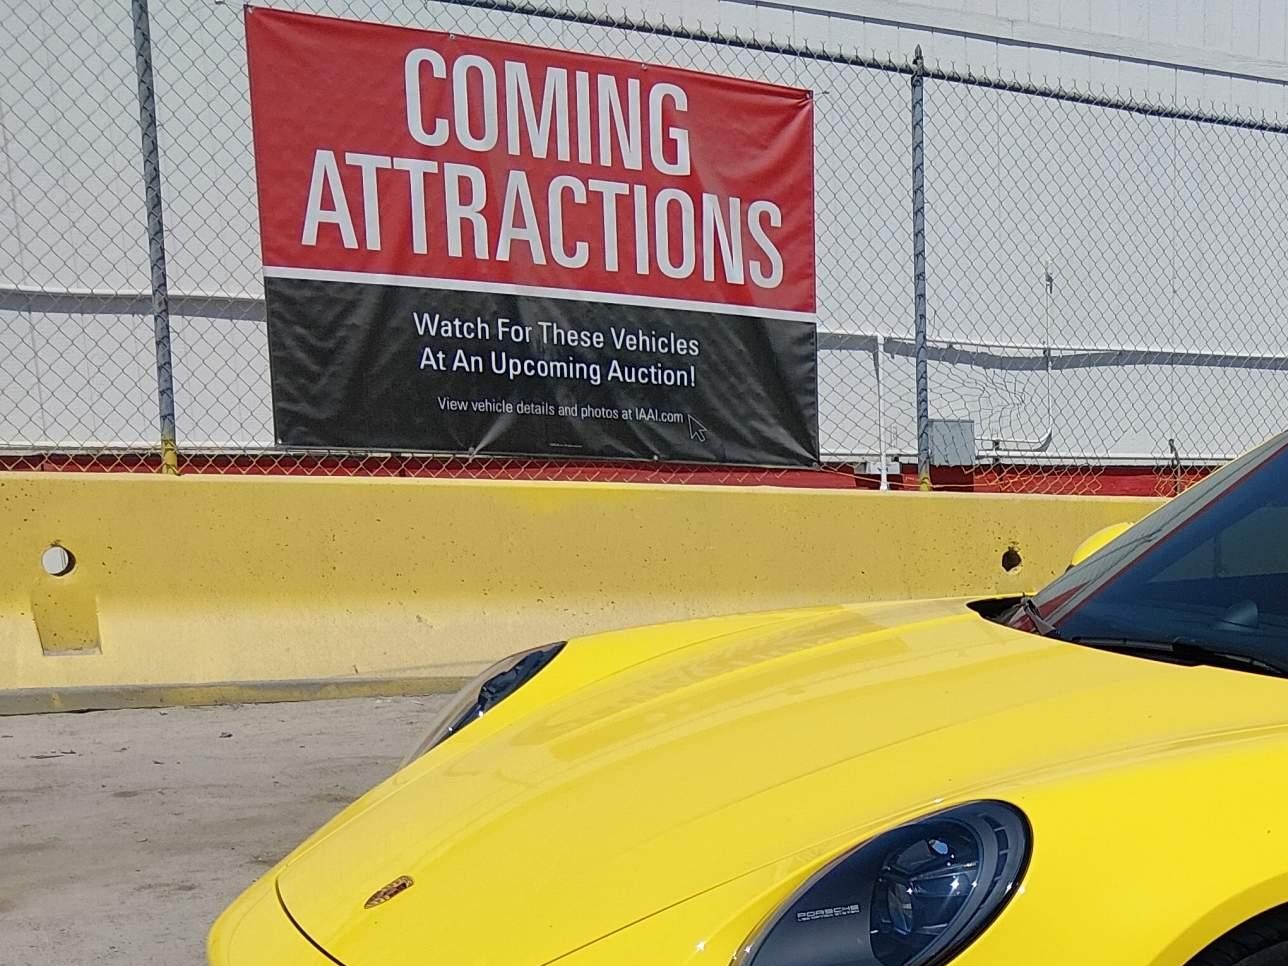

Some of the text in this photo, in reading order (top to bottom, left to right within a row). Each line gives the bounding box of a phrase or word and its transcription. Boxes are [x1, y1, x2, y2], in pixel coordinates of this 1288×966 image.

[404, 48, 692, 177] COMING
[301, 149, 785, 289] ATTRACTIONS
[413, 312, 700, 356] Watch For These Vehicles
[420, 347, 696, 387] At An Upcoming Auction!
[437, 396, 684, 423] View vehicle details and photos at IAAI.com
